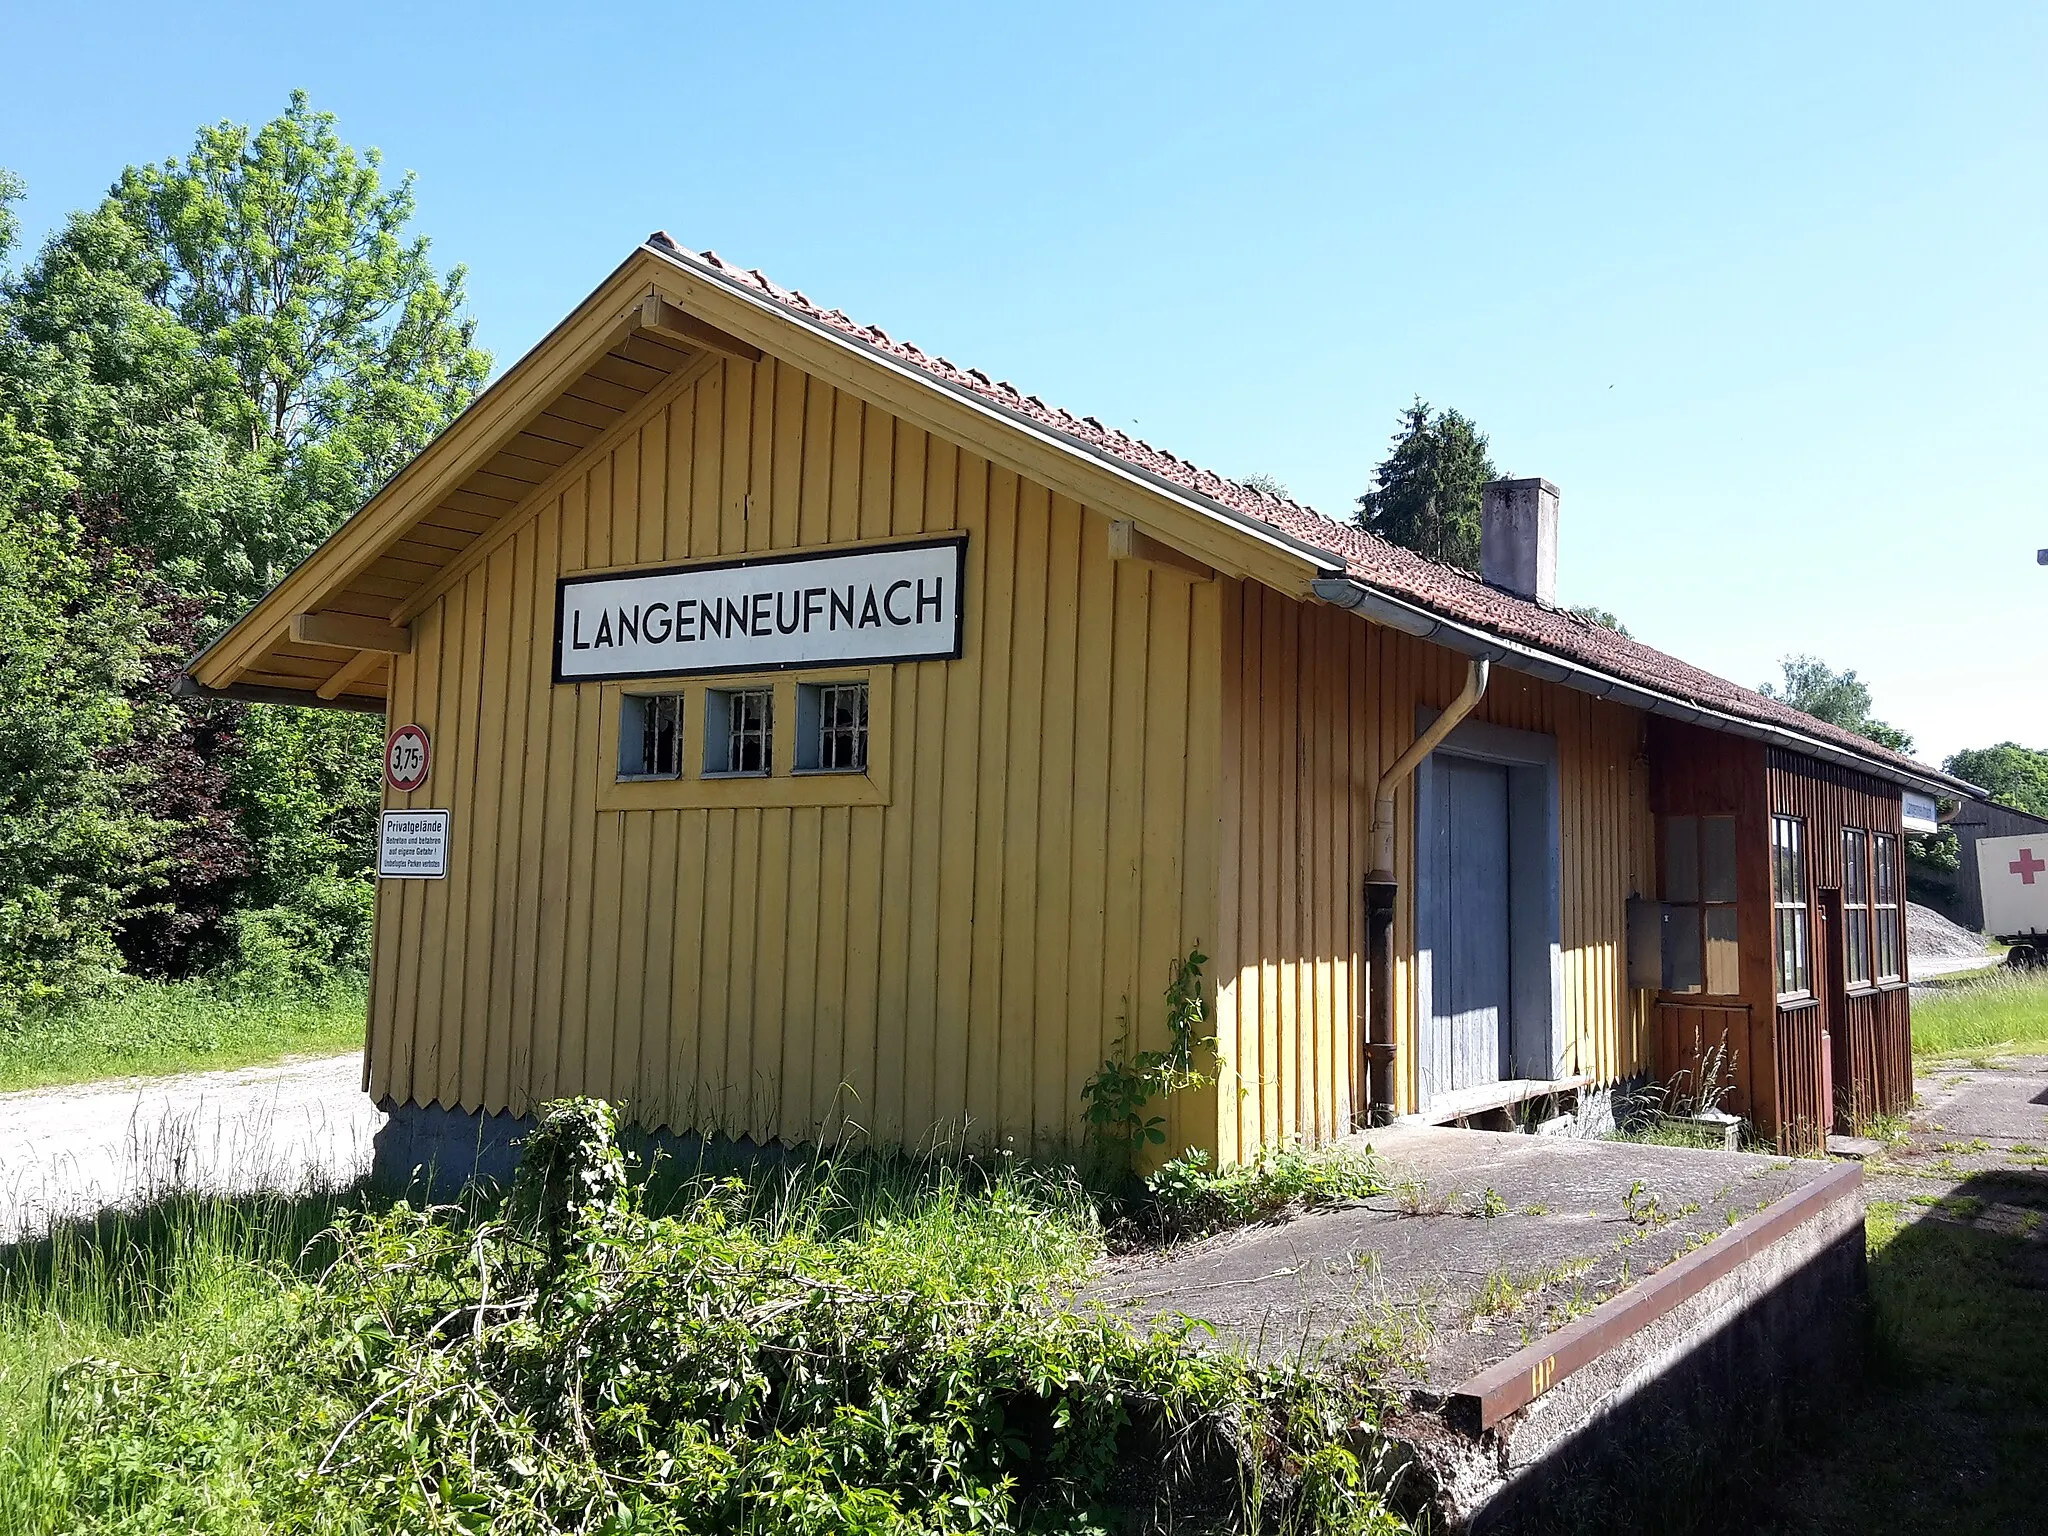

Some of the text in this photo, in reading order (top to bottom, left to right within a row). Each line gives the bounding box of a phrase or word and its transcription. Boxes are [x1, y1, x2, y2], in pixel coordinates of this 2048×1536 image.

[573, 577, 943, 649] LANGENNEUFNACH
[387, 820, 442, 834] Privatgelände
[398, 848, 415, 856] eigene
[408, 859, 421, 867] Parken
